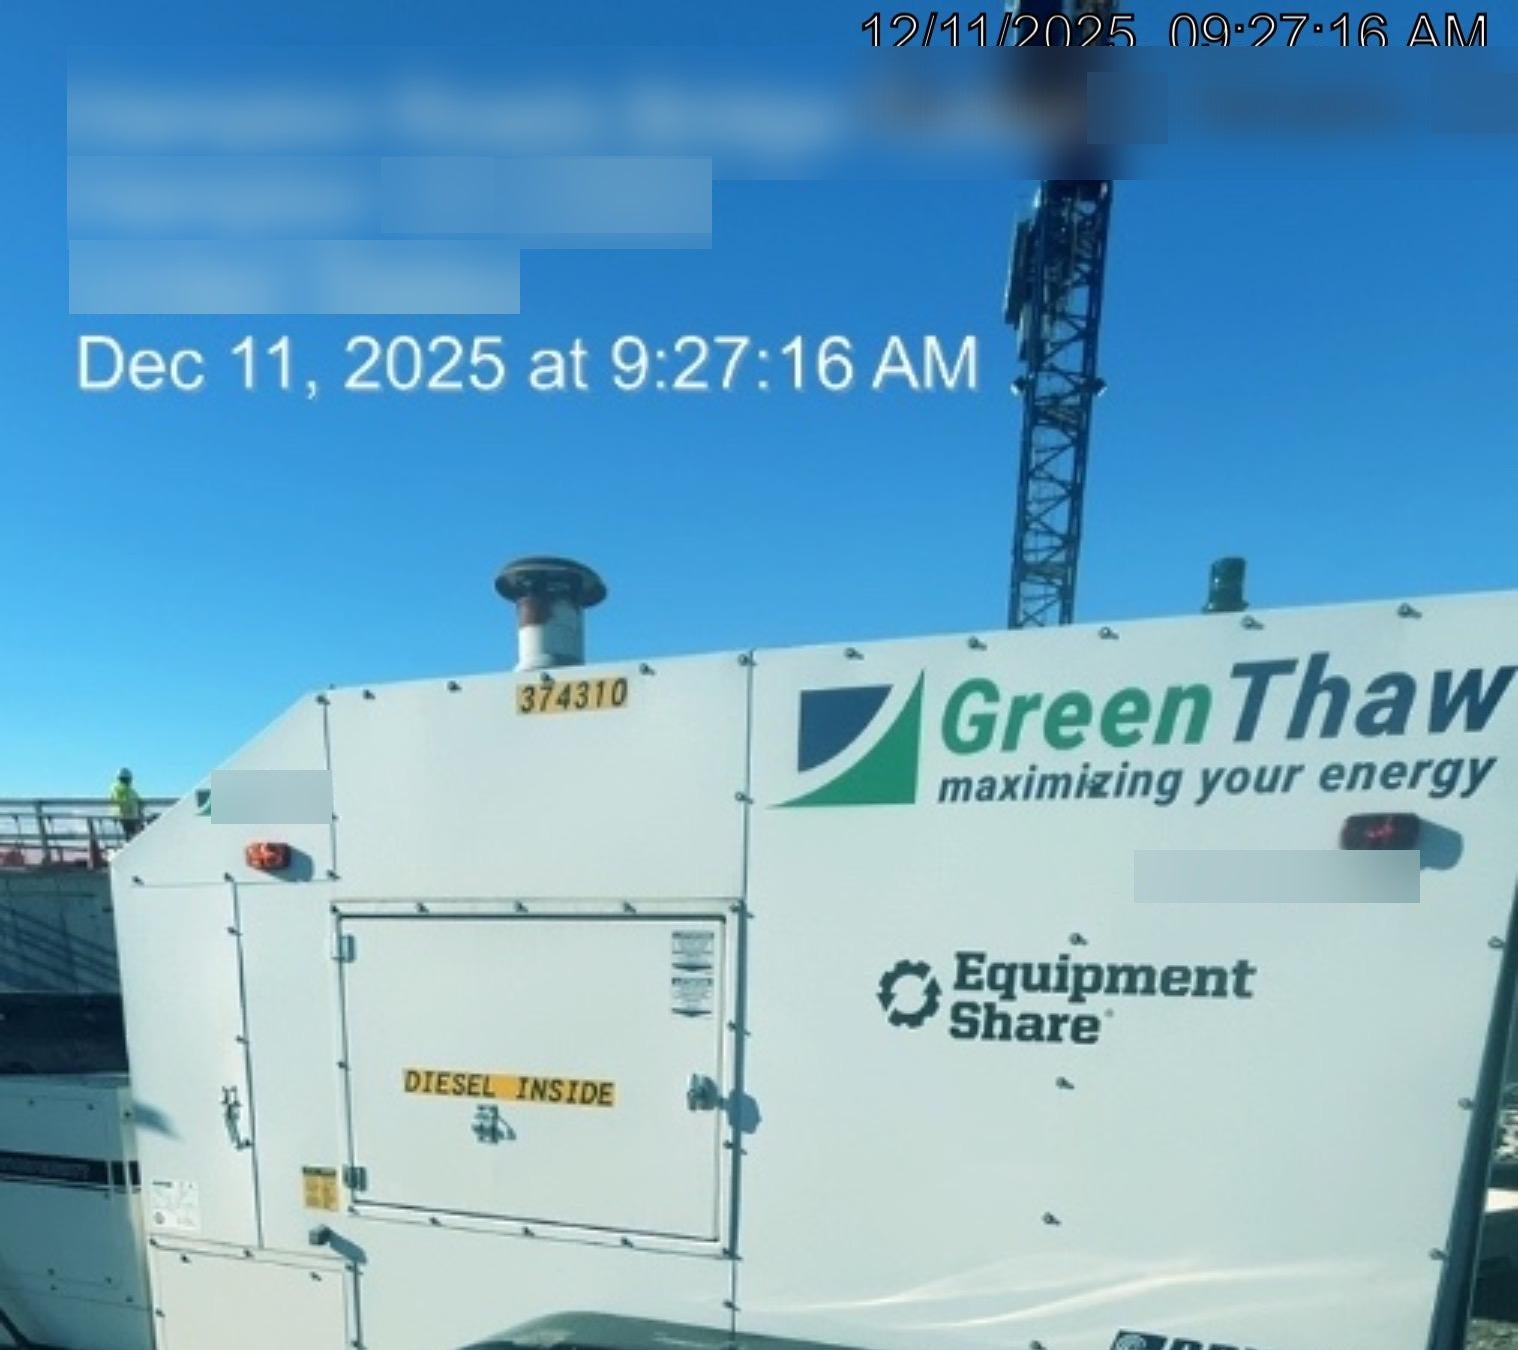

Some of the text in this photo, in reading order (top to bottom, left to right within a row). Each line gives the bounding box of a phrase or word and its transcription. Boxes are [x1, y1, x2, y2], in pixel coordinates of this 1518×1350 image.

[521, 679, 627, 712] 374310
[939, 758, 1498, 806] maximizing your energy
[953, 952, 1258, 1005] Equipment
[949, 1003, 1101, 1046] Share
[404, 1070, 614, 1107] DIESEL INSIDE
